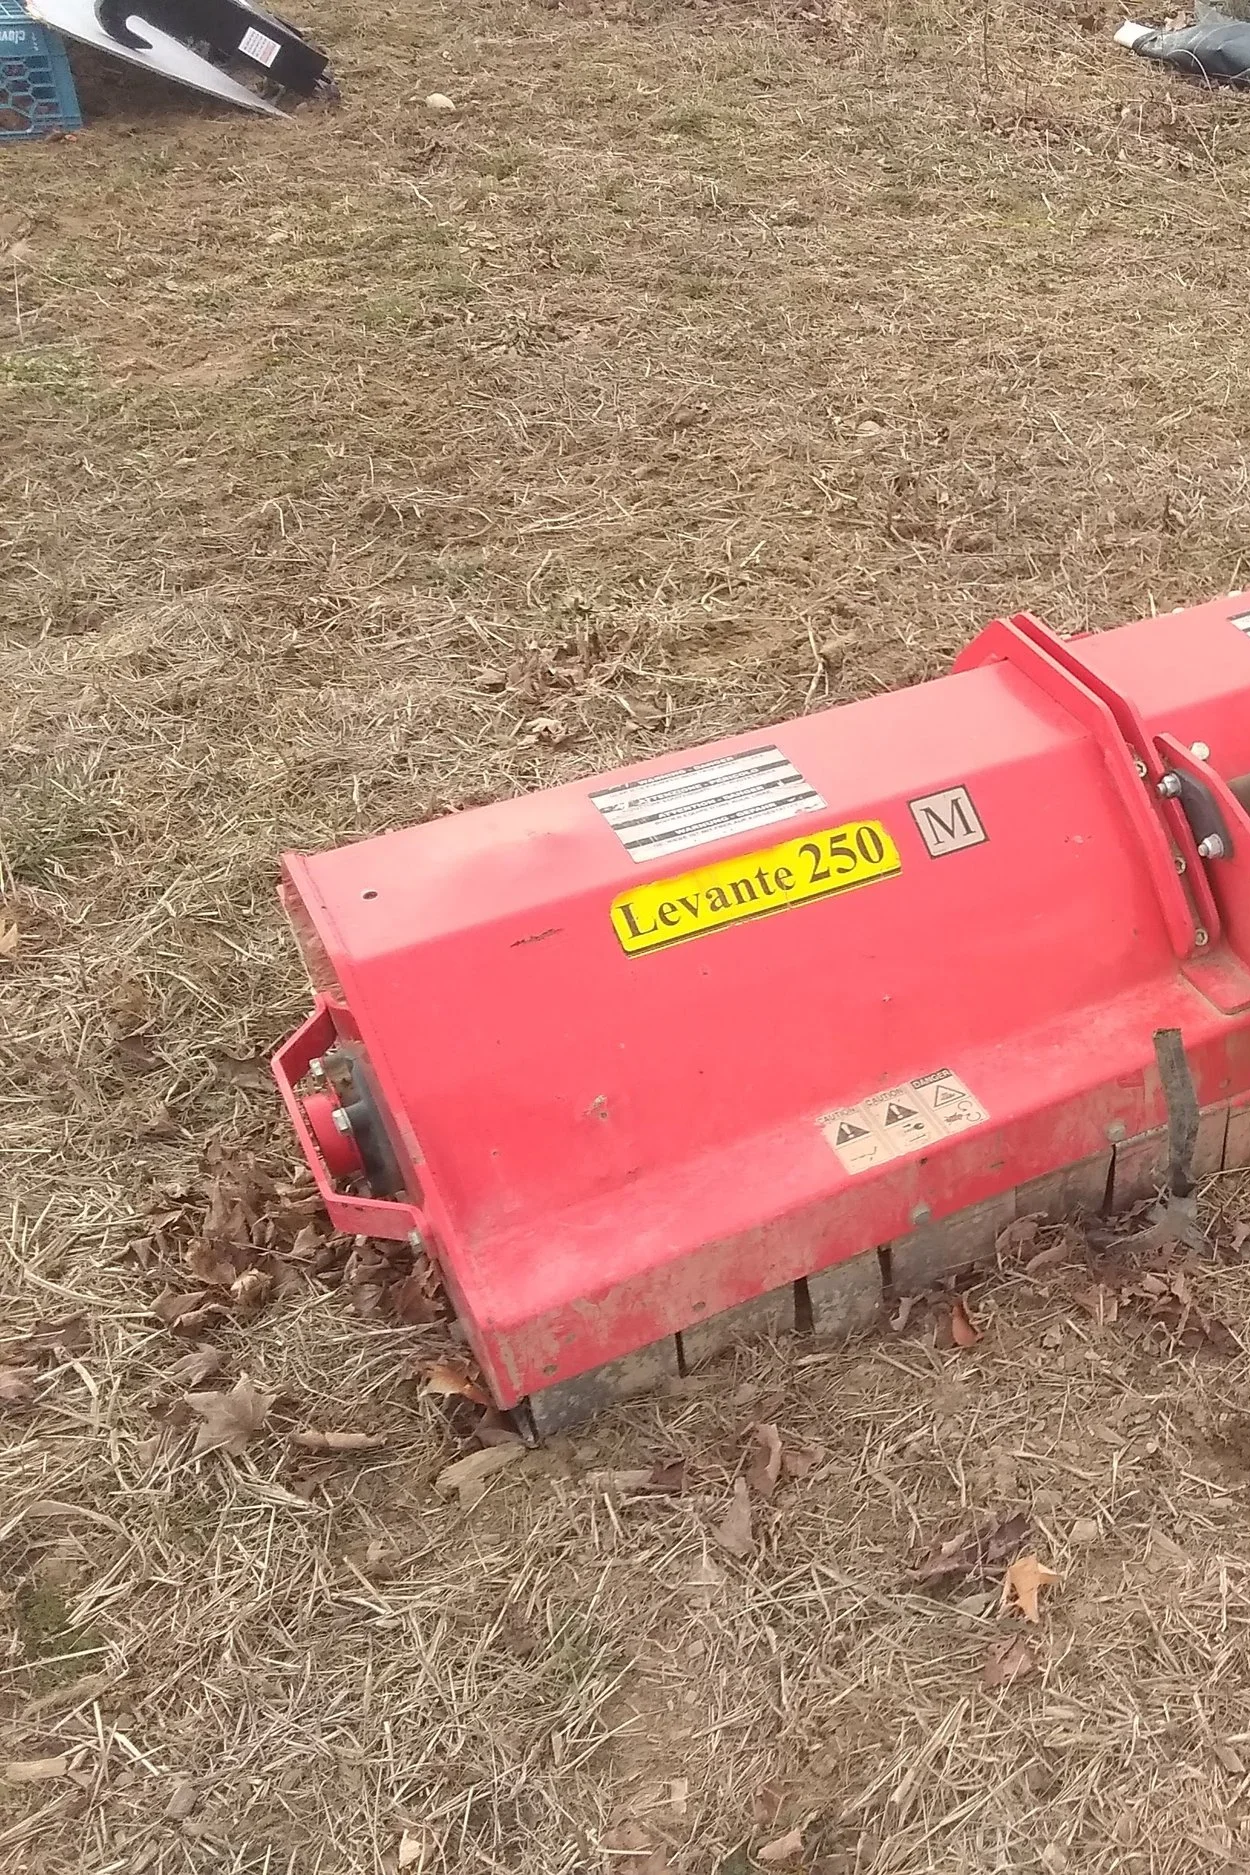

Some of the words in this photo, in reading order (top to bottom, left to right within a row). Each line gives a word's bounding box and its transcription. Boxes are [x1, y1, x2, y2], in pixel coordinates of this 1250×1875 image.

[0, 29, 26, 44] clov
[636, 768, 687, 785] WARNING
[656, 798, 717, 819] ATTENTION
[721, 785, 765, 800] DANGER
[673, 815, 729, 835] WARNUNG
[734, 801, 777, 817] GEFAHR
[919, 797, 977, 846] M
[617, 862, 797, 940] Levante
[798, 825, 885, 883] 250
[913, 1068, 951, 1089] DANGER
[864, 1088, 904, 1107] CAUTION
